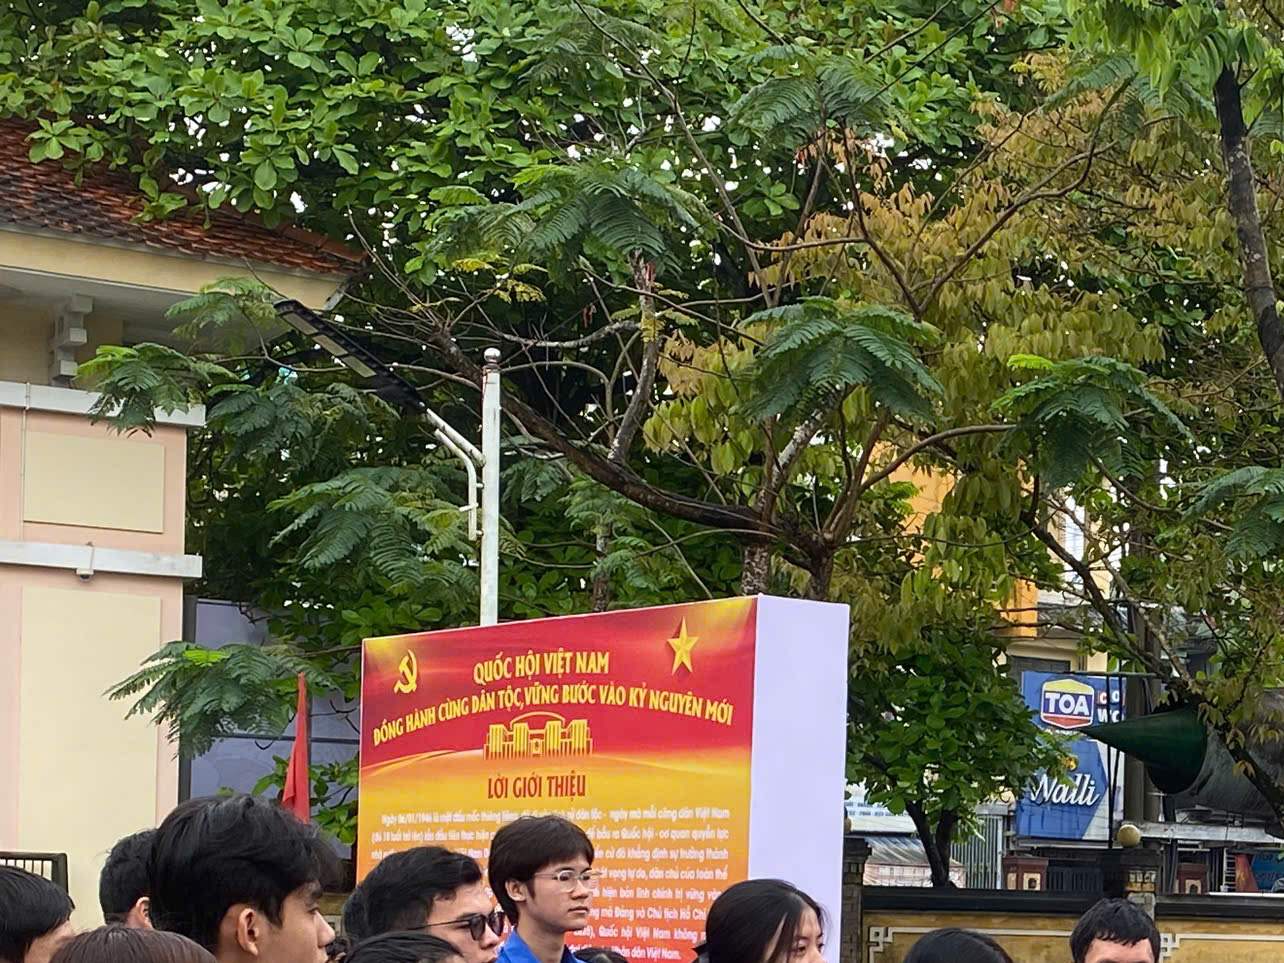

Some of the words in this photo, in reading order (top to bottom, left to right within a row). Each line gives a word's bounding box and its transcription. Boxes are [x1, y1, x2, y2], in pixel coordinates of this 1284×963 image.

[473, 651, 512, 686] QUỐC
[515, 649, 541, 680] HỘI
[543, 647, 573, 679] VIỆT
[575, 651, 609, 674] NAM
[373, 717, 404, 747] ĐỒNG
[405, 706, 436, 733] HÀNH
[438, 697, 469, 722] CÙNG
[471, 689, 495, 714] DÂN
[499, 685, 524, 712] TỘC,
[524, 681, 559, 705] VỮNG
[561, 680, 597, 704] BƯỚC
[599, 680, 626, 705] VÀO
[628, 682, 648, 708] KỶ
[649, 689, 703, 718] NGUYÊN
[705, 698, 734, 726] MỚI
[1045, 692, 1090, 716] TOA
[487, 772, 509, 799] LỜI
[513, 771, 542, 798] GIỚI
[547, 769, 586, 802] THIỆU
